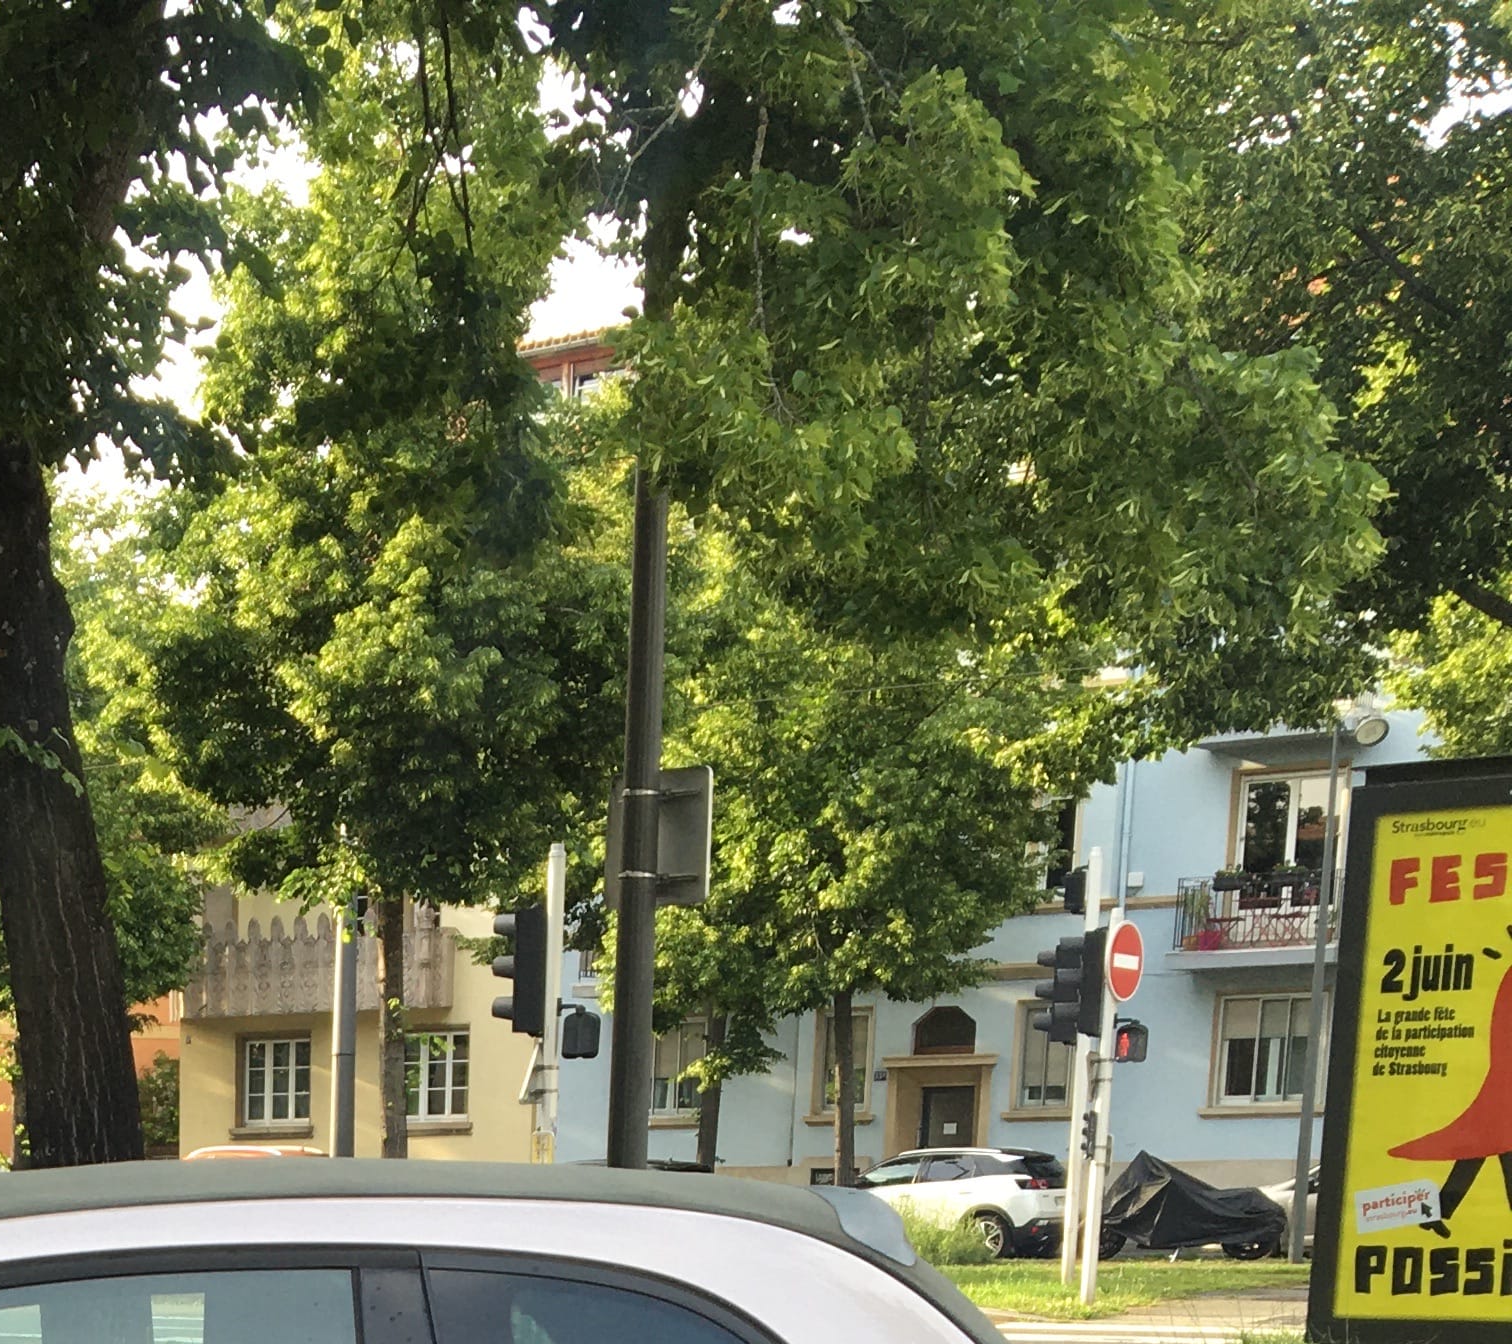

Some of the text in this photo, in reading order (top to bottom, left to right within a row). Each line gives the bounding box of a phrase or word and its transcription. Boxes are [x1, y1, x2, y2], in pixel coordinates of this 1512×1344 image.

[1389, 852, 1508, 906] FES
[1381, 944, 1474, 1001] 2 juin
[1377, 1009, 1391, 1023] La
[1394, 1007, 1431, 1025] grande
[1376, 1024, 1475, 1042] de la participation
[1374, 1044, 1426, 1060] citoyenne
[1372, 1061, 1448, 1077] de Strasbourg
[1362, 1190, 1430, 1216] participer
